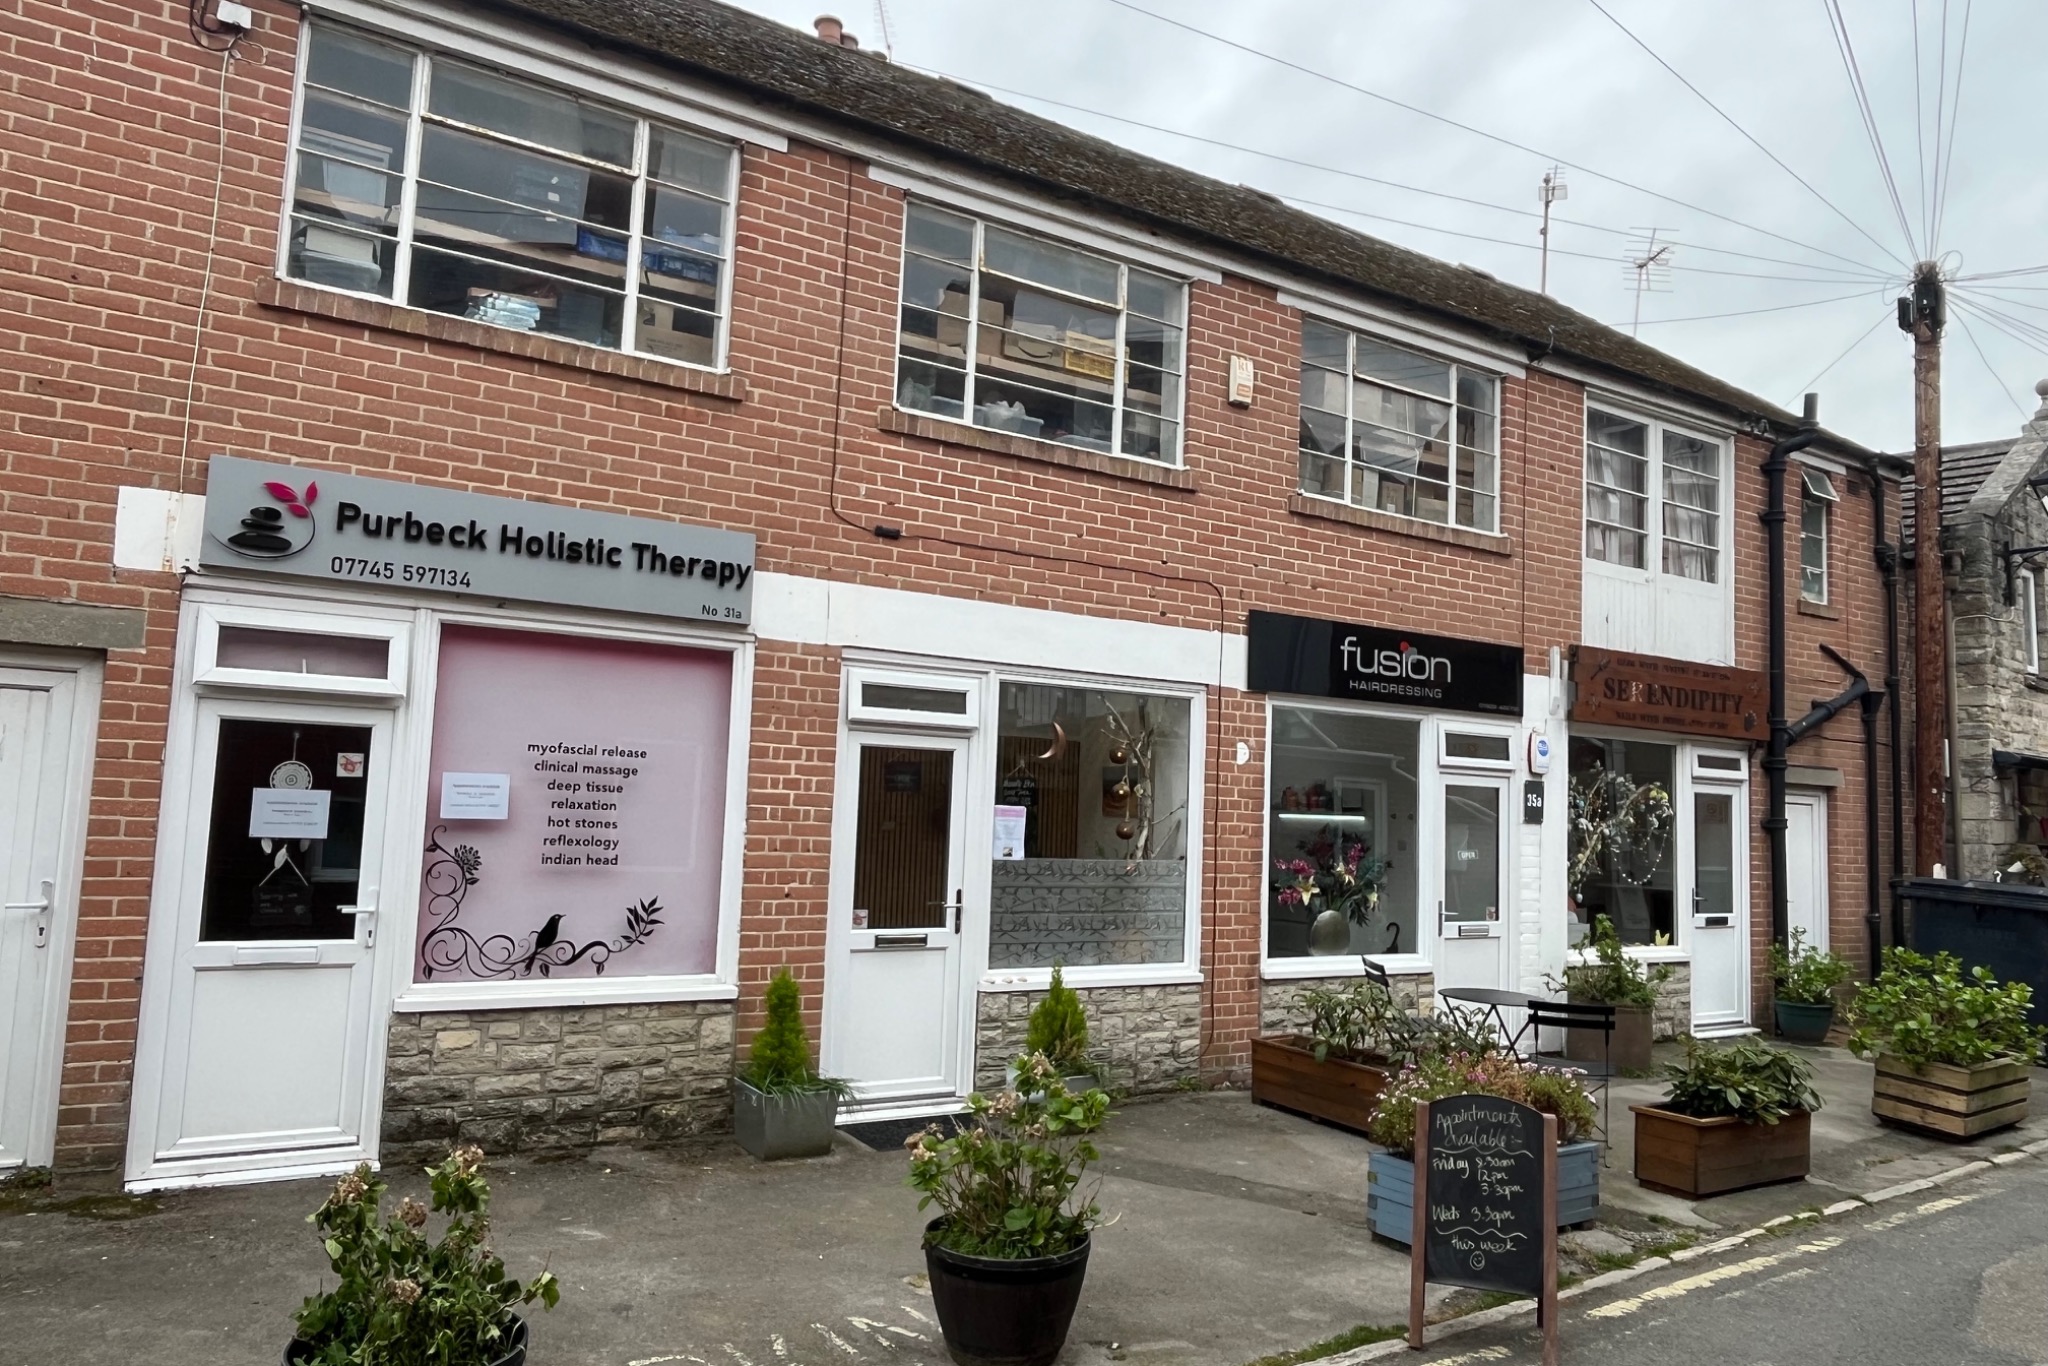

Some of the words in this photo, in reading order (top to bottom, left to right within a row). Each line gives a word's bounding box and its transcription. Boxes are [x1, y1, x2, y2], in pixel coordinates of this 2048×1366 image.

[335, 501, 488, 551] Purbeck
[499, 525, 622, 567] Holistic
[631, 542, 752, 590] Therapy
[330, 556, 395, 580] 07745
[402, 564, 472, 589] 597134
[701, 604, 718, 617] No
[724, 606, 742, 620] 31a
[1340, 636, 1451, 682] fusion
[1350, 679, 1442, 699] HAIRDRESSING
[1603, 677, 1744, 715] SERENDIPITY
[527, 741, 598, 756] myofascial
[602, 746, 647, 759] release
[534, 759, 578, 774] clinical
[582, 764, 639, 779] massage
[547, 779, 581, 794] deep
[586, 781, 624, 794] tissue
[551, 798, 617, 811] relaxation
[1527, 794, 1542, 807] 35a
[547, 815, 571, 828] hot
[575, 817, 618, 829] stones
[543, 834, 619, 851] reflexology
[541, 853, 581, 866] indian
[586, 853, 619, 866] head
[1433, 1154, 1470, 1179] Friday
[1451, 1234, 1475, 1250] this
[1480, 1238, 1517, 1253] week
